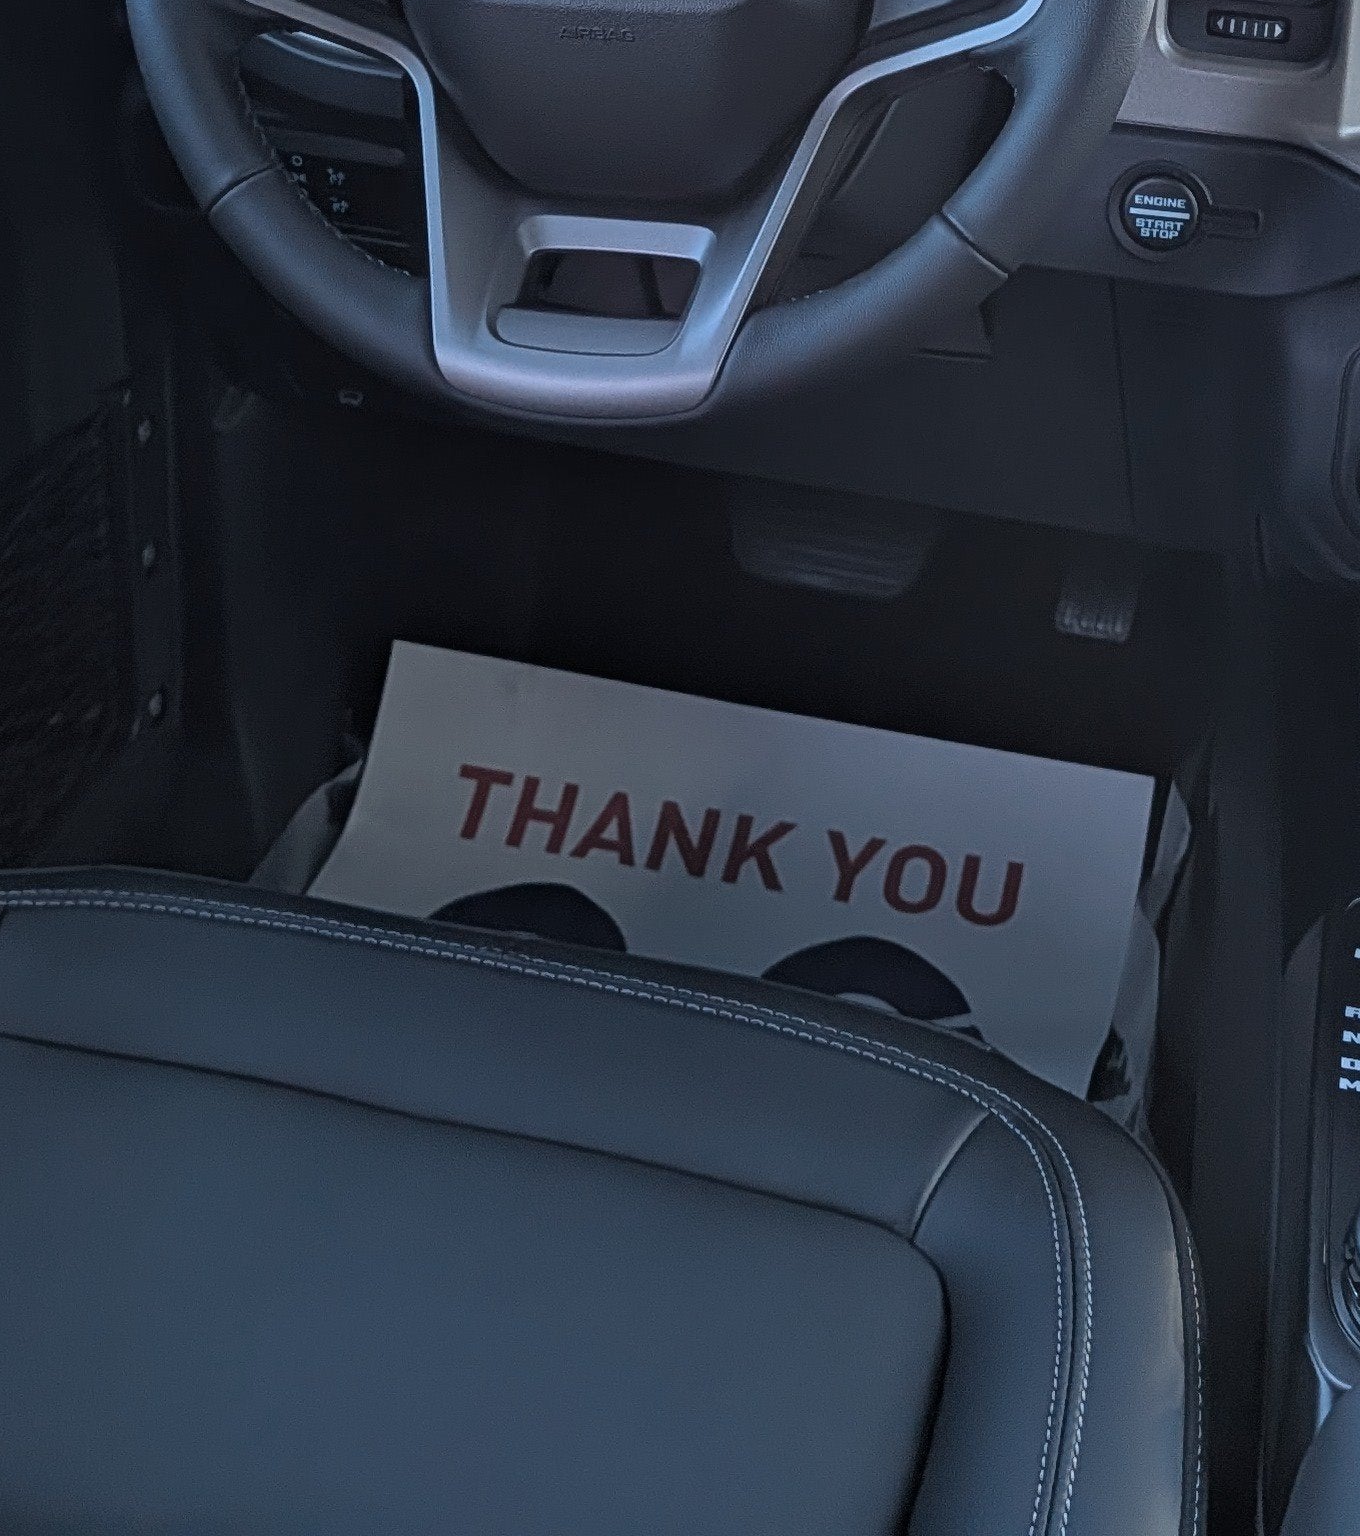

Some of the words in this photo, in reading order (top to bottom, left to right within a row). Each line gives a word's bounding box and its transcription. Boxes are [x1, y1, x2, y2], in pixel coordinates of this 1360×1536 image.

[1134, 194, 1187, 210] ENGINE
[1135, 217, 1185, 231] START
[1140, 227, 1179, 240] STOP
[459, 764, 797, 893] THANK
[827, 830, 1025, 927] YOU
